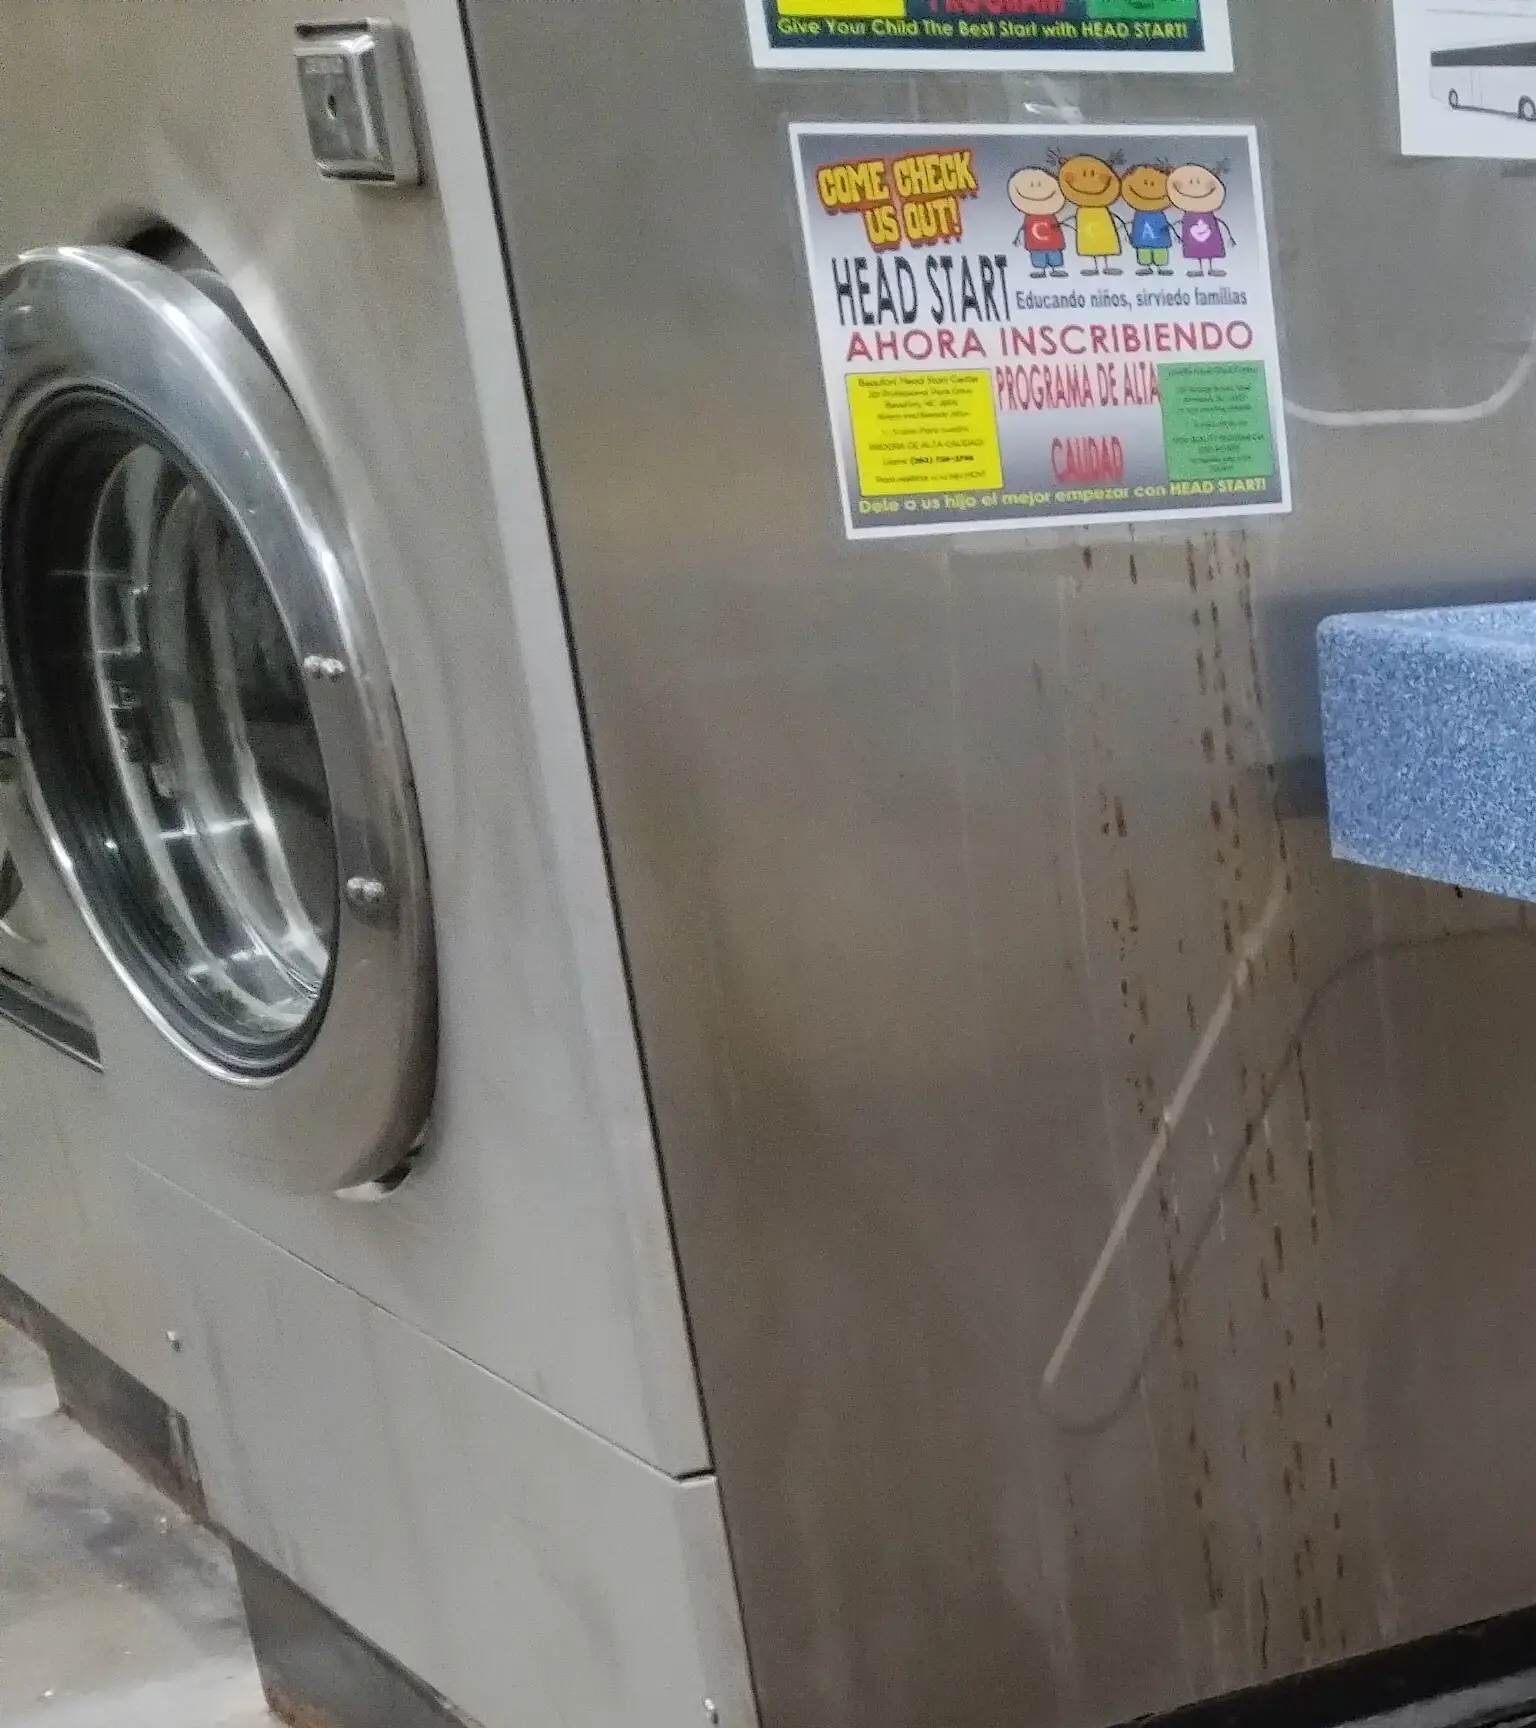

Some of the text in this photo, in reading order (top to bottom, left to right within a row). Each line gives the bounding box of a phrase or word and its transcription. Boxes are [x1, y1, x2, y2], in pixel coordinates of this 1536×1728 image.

[777, 18, 1188, 39] Give Your Child The Best Start with HEAD START!
[818, 150, 978, 207] COME CHECK
[864, 197, 962, 245] US OUT!
[831, 253, 1011, 327] HEAD START
[1015, 286, 1248, 312] Educando niños, sirviedo familias
[846, 319, 1253, 362] AHORA INSCRIBIENDO
[995, 359, 1160, 411] PROGRAMA DE ALTA
[1051, 436, 1124, 482] CALIDAD
[922, 497, 941, 510] us
[945, 493, 977, 511] hijo
[981, 491, 999, 506] el
[1002, 490, 1050, 506] mejor
[1055, 486, 1129, 503] empezar
[1134, 485, 1167, 498] con
[1170, 480, 1215, 496] HEAD
[1217, 477, 1266, 493] START!
